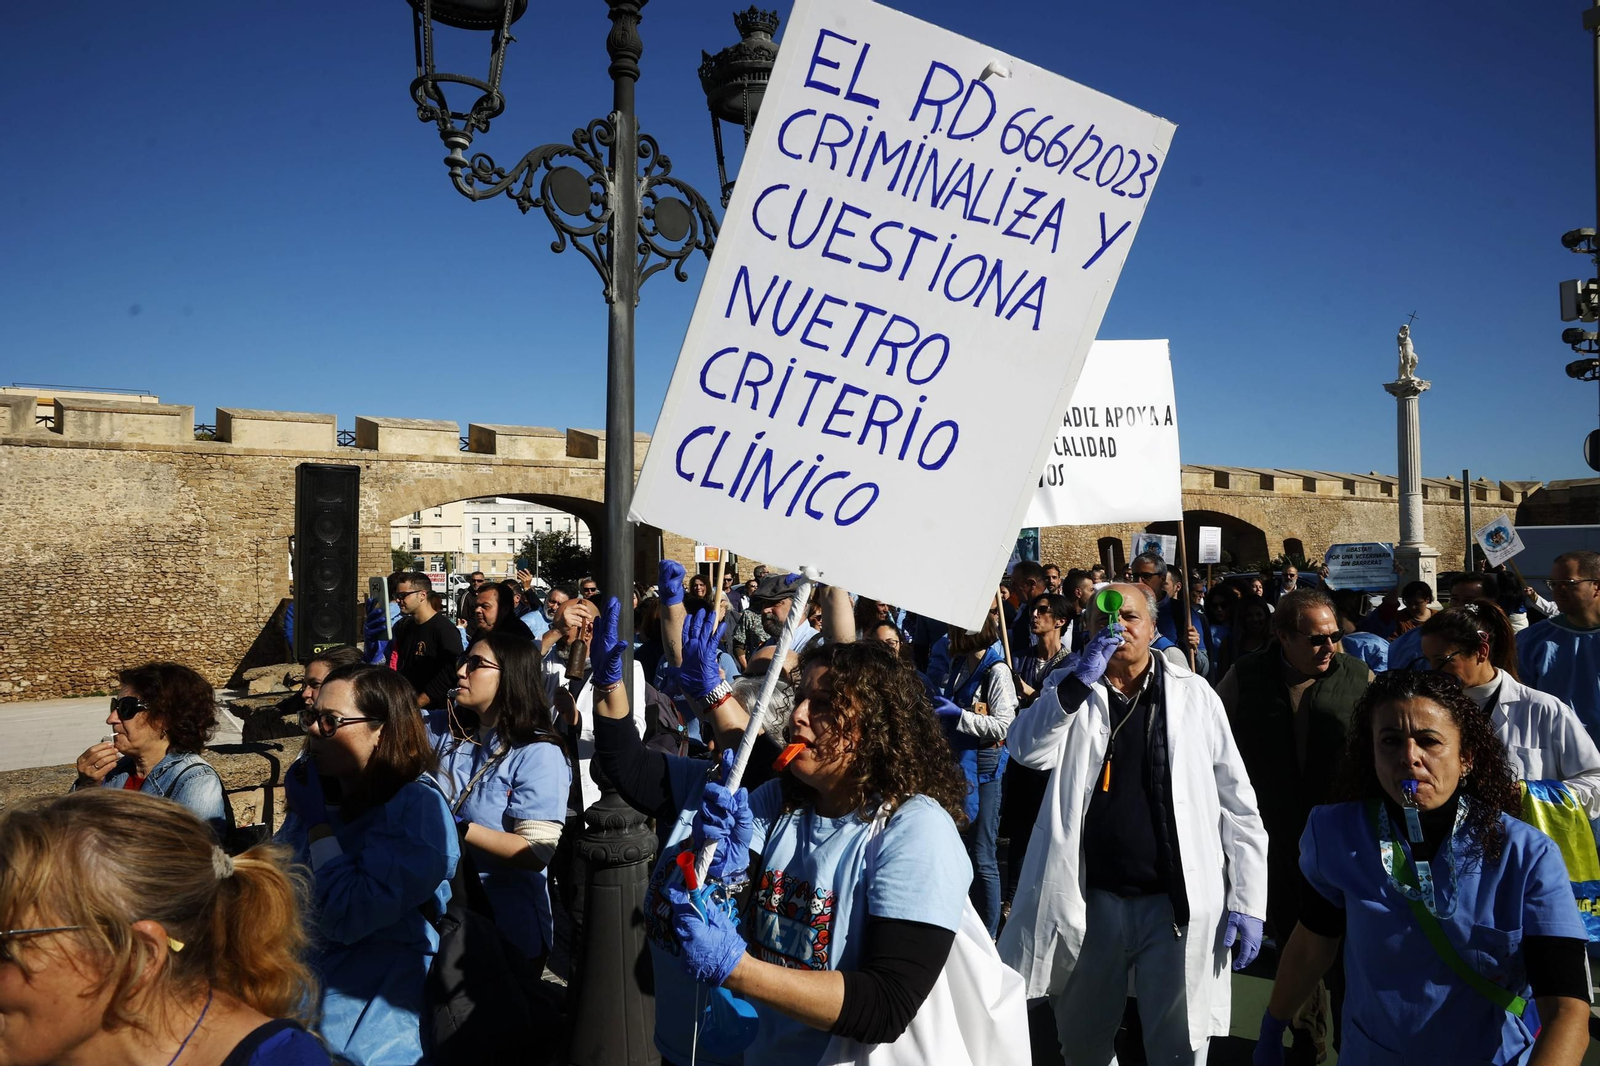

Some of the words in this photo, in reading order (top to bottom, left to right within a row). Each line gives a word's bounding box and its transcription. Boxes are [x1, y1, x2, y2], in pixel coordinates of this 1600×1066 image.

[804, 28, 880, 109] EL
[1000, 107, 1158, 199] 666/2023
[1082, 212, 1132, 270] Y
[725, 265, 951, 386] NUETRO
[1061, 406, 1099, 428] ADIZ
[1105, 406, 1159, 428] APOYA
[1164, 405, 1174, 426] A
